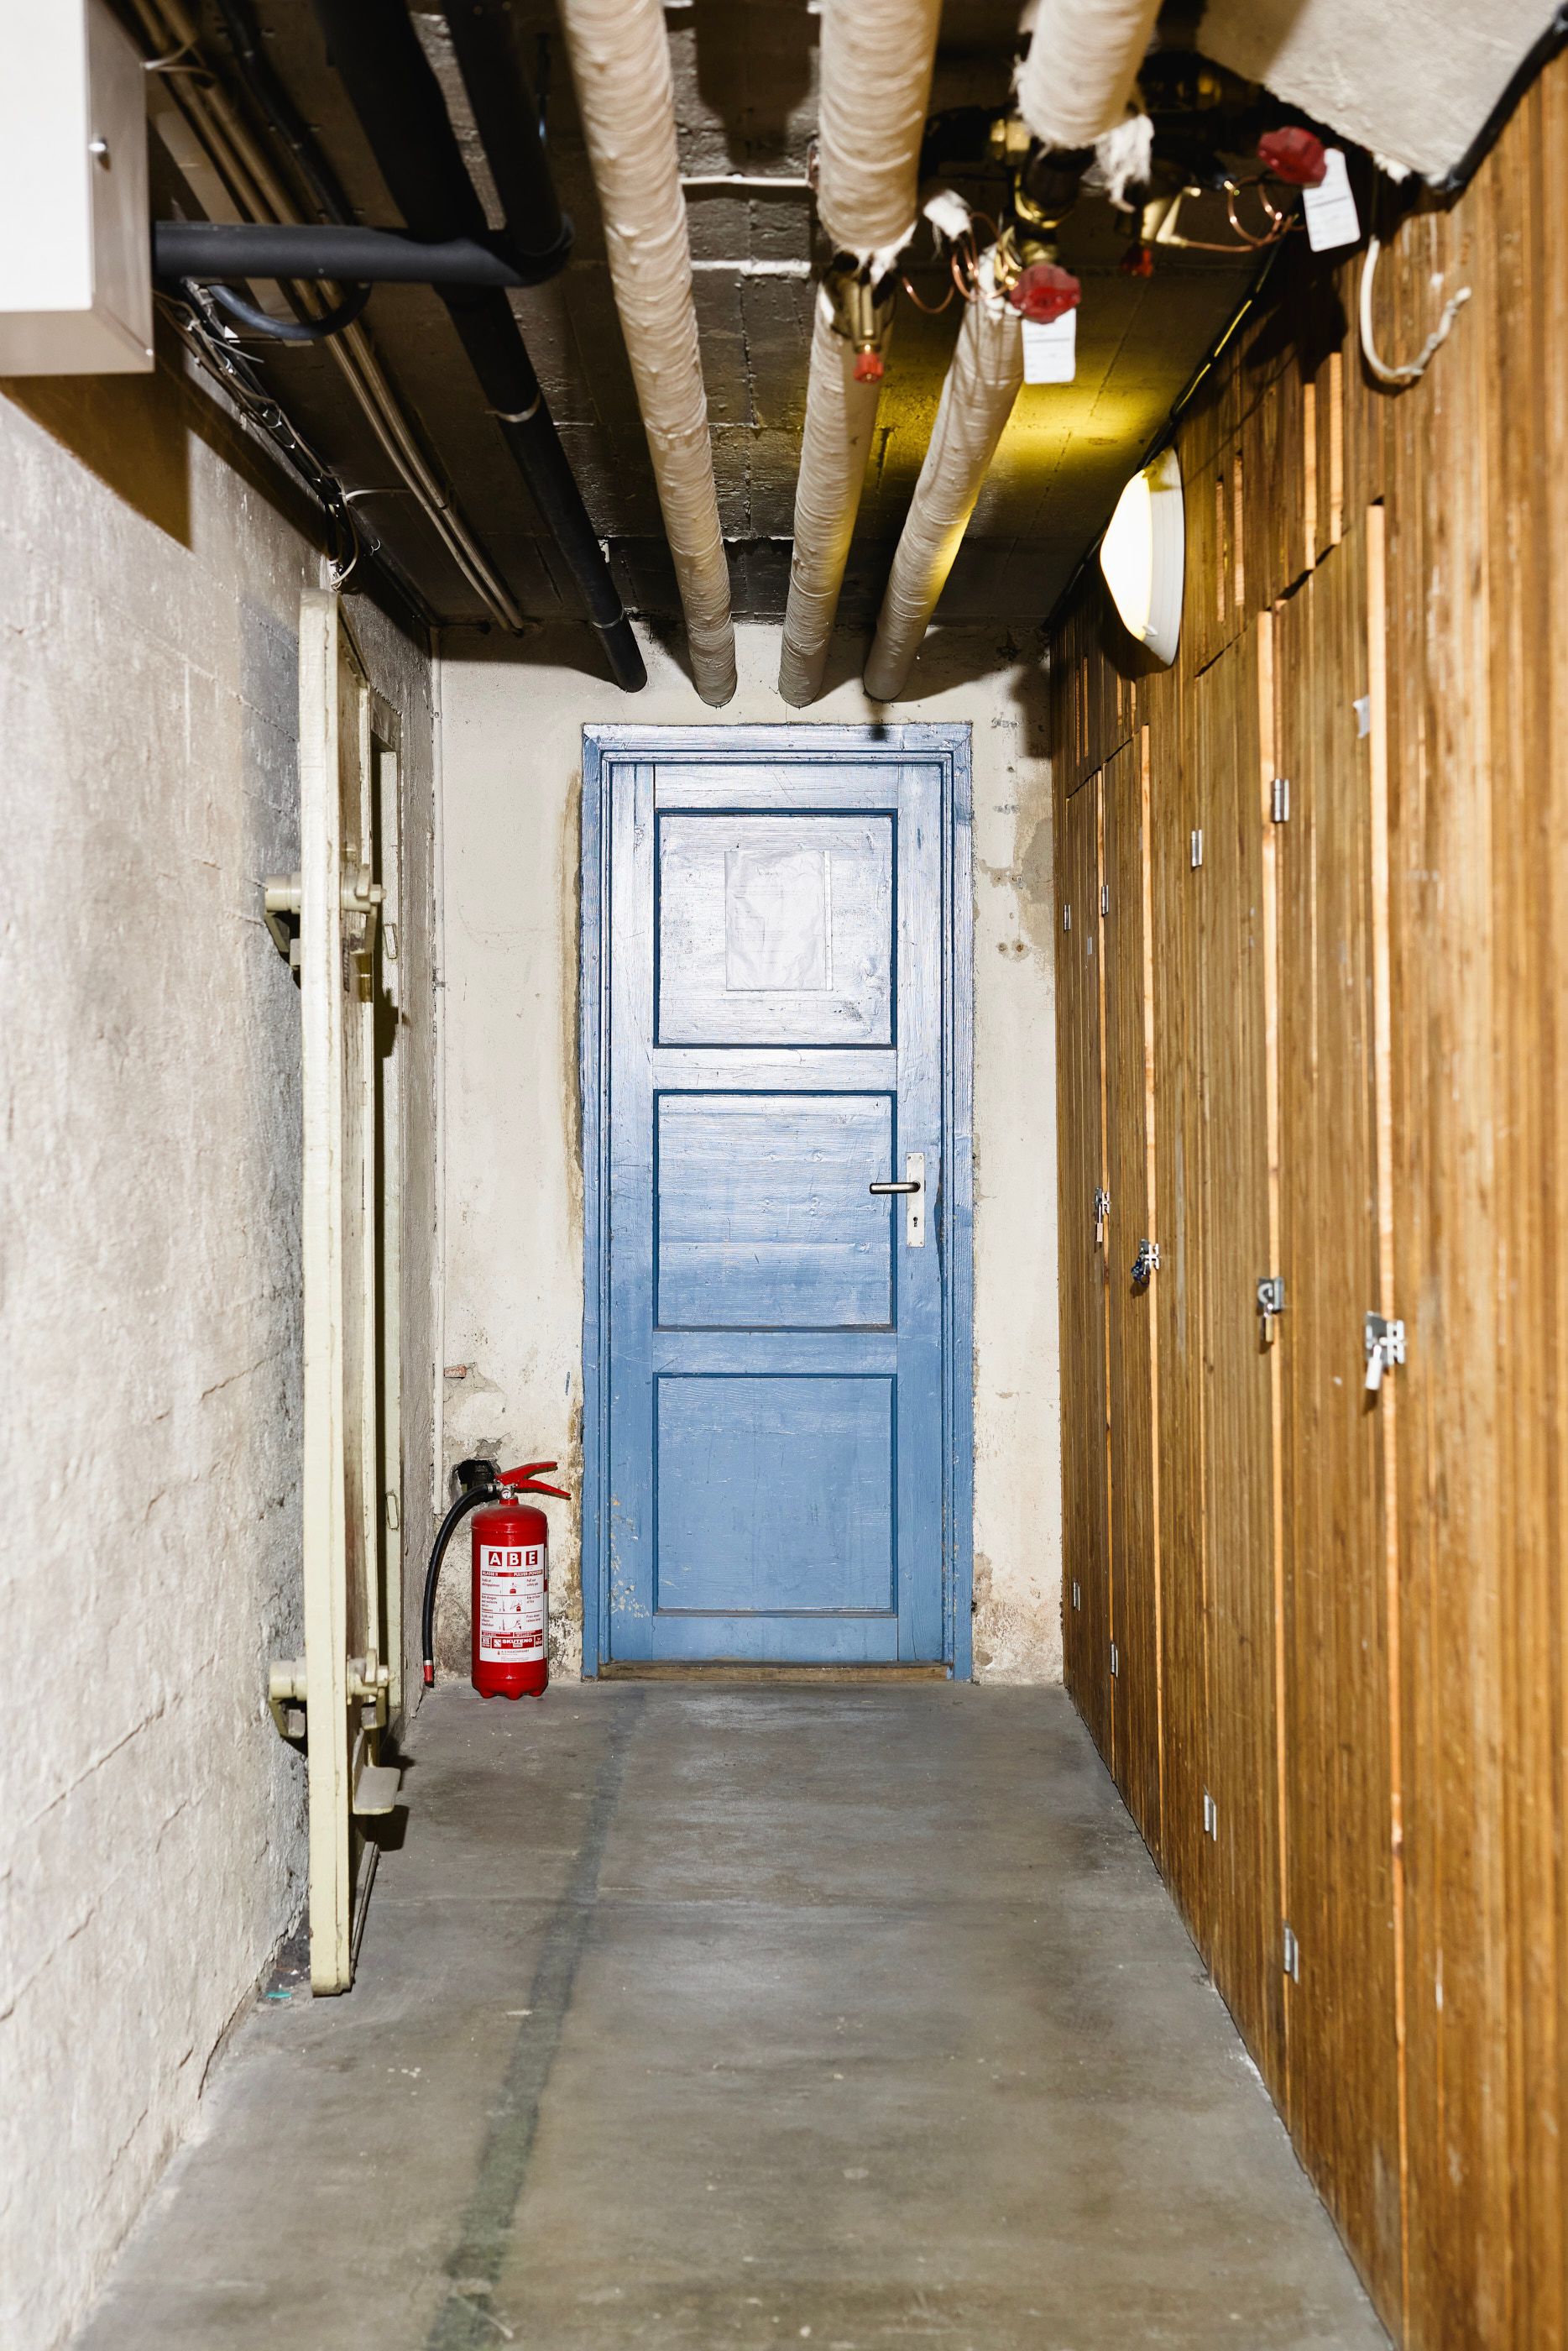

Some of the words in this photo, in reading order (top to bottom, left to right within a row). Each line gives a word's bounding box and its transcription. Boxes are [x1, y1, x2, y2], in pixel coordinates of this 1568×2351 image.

[489, 1552, 501, 1565] A
[510, 1552, 519, 1565] B
[529, 1552, 536, 1564] E
